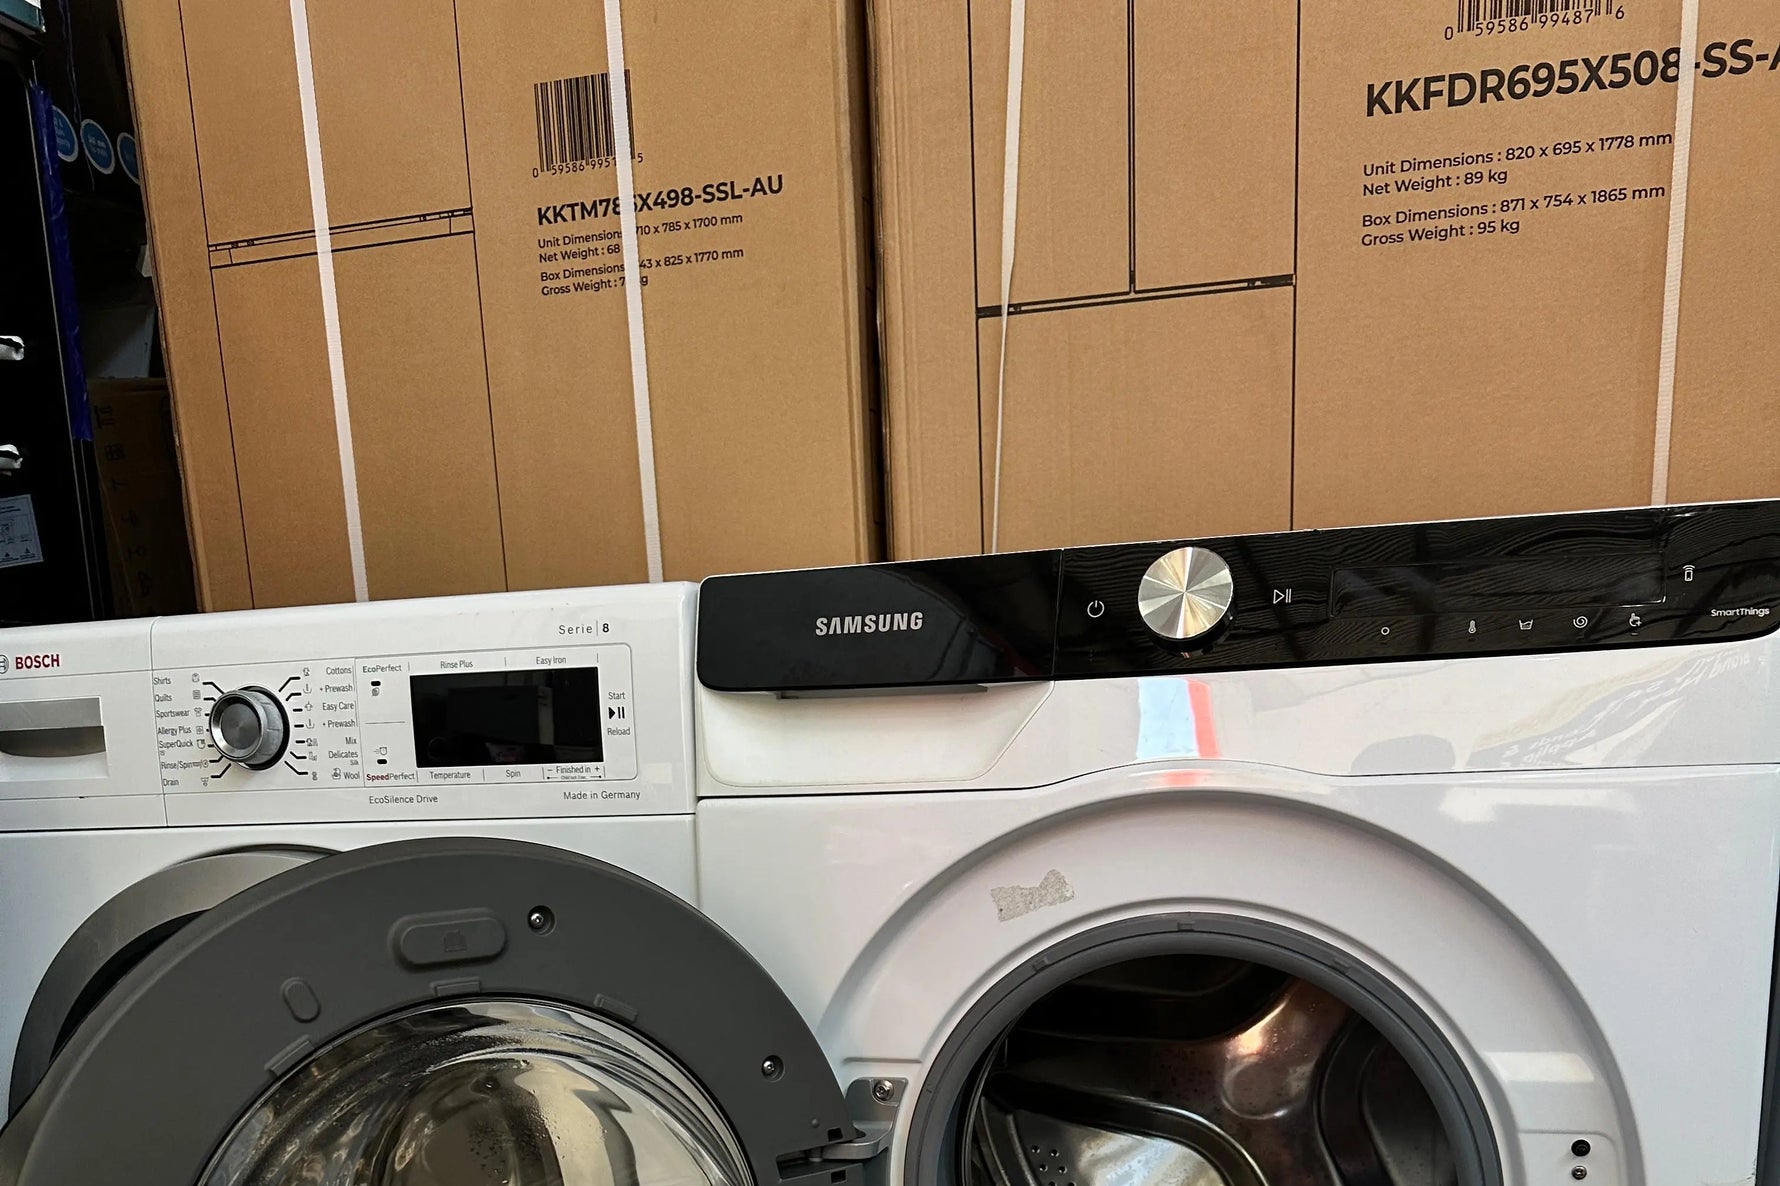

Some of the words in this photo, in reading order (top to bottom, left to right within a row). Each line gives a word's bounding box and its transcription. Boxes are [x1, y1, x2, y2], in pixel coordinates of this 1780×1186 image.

[1444, 26, 1454, 41] 0
[1475, 16, 1529, 37] 59586
[1539, 9, 1594, 29] 99487
[1615, 5, 1625, 20] 6
[1363, 161, 1396, 177] Unit
[1400, 152, 1494, 173] Dimensions
[1505, 145, 1535, 161] 820
[1539, 146, 1549, 158] x
[1552, 140, 1582, 155] 695
[1585, 141, 1595, 152] x
[1599, 135, 1635, 151] 1778
[1639, 133, 1673, 147] mm
[551, 161, 585, 176] 59586
[1362, 182, 1391, 197] Net
[1394, 175, 1453, 193] Weight
[1464, 171, 1484, 185] 89
[1488, 169, 1508, 185] kg
[537, 174, 784, 226] KKTM78X498-SSL-AU
[1362, 214, 1392, 228] Box
[1395, 204, 1488, 225] Dimensions
[1500, 198, 1526, 213] 871
[1530, 198, 1540, 210] x
[1543, 192, 1574, 209] 754
[1577, 193, 1587, 205] x
[1591, 187, 1627, 204] 1865
[1632, 186, 1666, 200] mm
[537, 236, 561, 249] Unit
[661, 220, 682, 233] 785
[692, 216, 718, 228] 1700
[720, 214, 743, 226] mm
[1361, 232, 1404, 247] Gross
[1408, 224, 1466, 242] Weight
[1477, 220, 1497, 235] 95
[1500, 218, 1521, 234] kg
[539, 252, 559, 263] Net
[560, 247, 600, 260] Weight
[606, 243, 621, 254] 68
[540, 271, 561, 282] Box
[562, 264, 625, 279] Dimensions
[664, 255, 684, 266] 825
[694, 250, 719, 263] 1770
[721, 248, 744, 260] mm
[541, 285, 571, 296] Gross
[572, 279, 612, 292] Weight
[1710, 607, 1770, 617] SmartThings
[558, 624, 593, 635] Serie
[602, 622, 610, 633] 8
[814, 611, 924, 637] SAMSUNG
[15, 653, 60, 670] BOSCH
[440, 660, 459, 669] Rinse
[459, 659, 474, 669] Plus
[535, 656, 552, 666] Easy
[552, 655, 567, 664] Iron
[325, 666, 352, 676] Cottons
[362, 664, 402, 674] EcoPerfect
[153, 677, 172, 686] Shirts
[324, 684, 353, 693] Prewash
[607, 691, 626, 700] Start
[322, 702, 338, 712] Easy
[338, 701, 355, 711] Care
[156, 709, 190, 719] Sportswear
[327, 719, 356, 728] Prewash
[157, 726, 178, 737] Allergy
[178, 726, 192, 734] Plus
[607, 726, 631, 736] Reload
[159, 739, 194, 749] SuperQuick
[345, 737, 358, 745] Mix
[328, 750, 359, 759] Delicates
[429, 770, 471, 780] Temperature
[505, 768, 521, 779] Spin
[556, 765, 584, 774] Finished
[343, 771, 360, 780] Wool
[366, 772, 415, 783] SpeedPerfect
[162, 778, 179, 787] Drain
[368, 795, 414, 805] EcoSilence
[416, 795, 439, 803] Drive
[563, 791, 588, 800] Made
[590, 790, 599, 799] in
[600, 790, 641, 801] Germany
